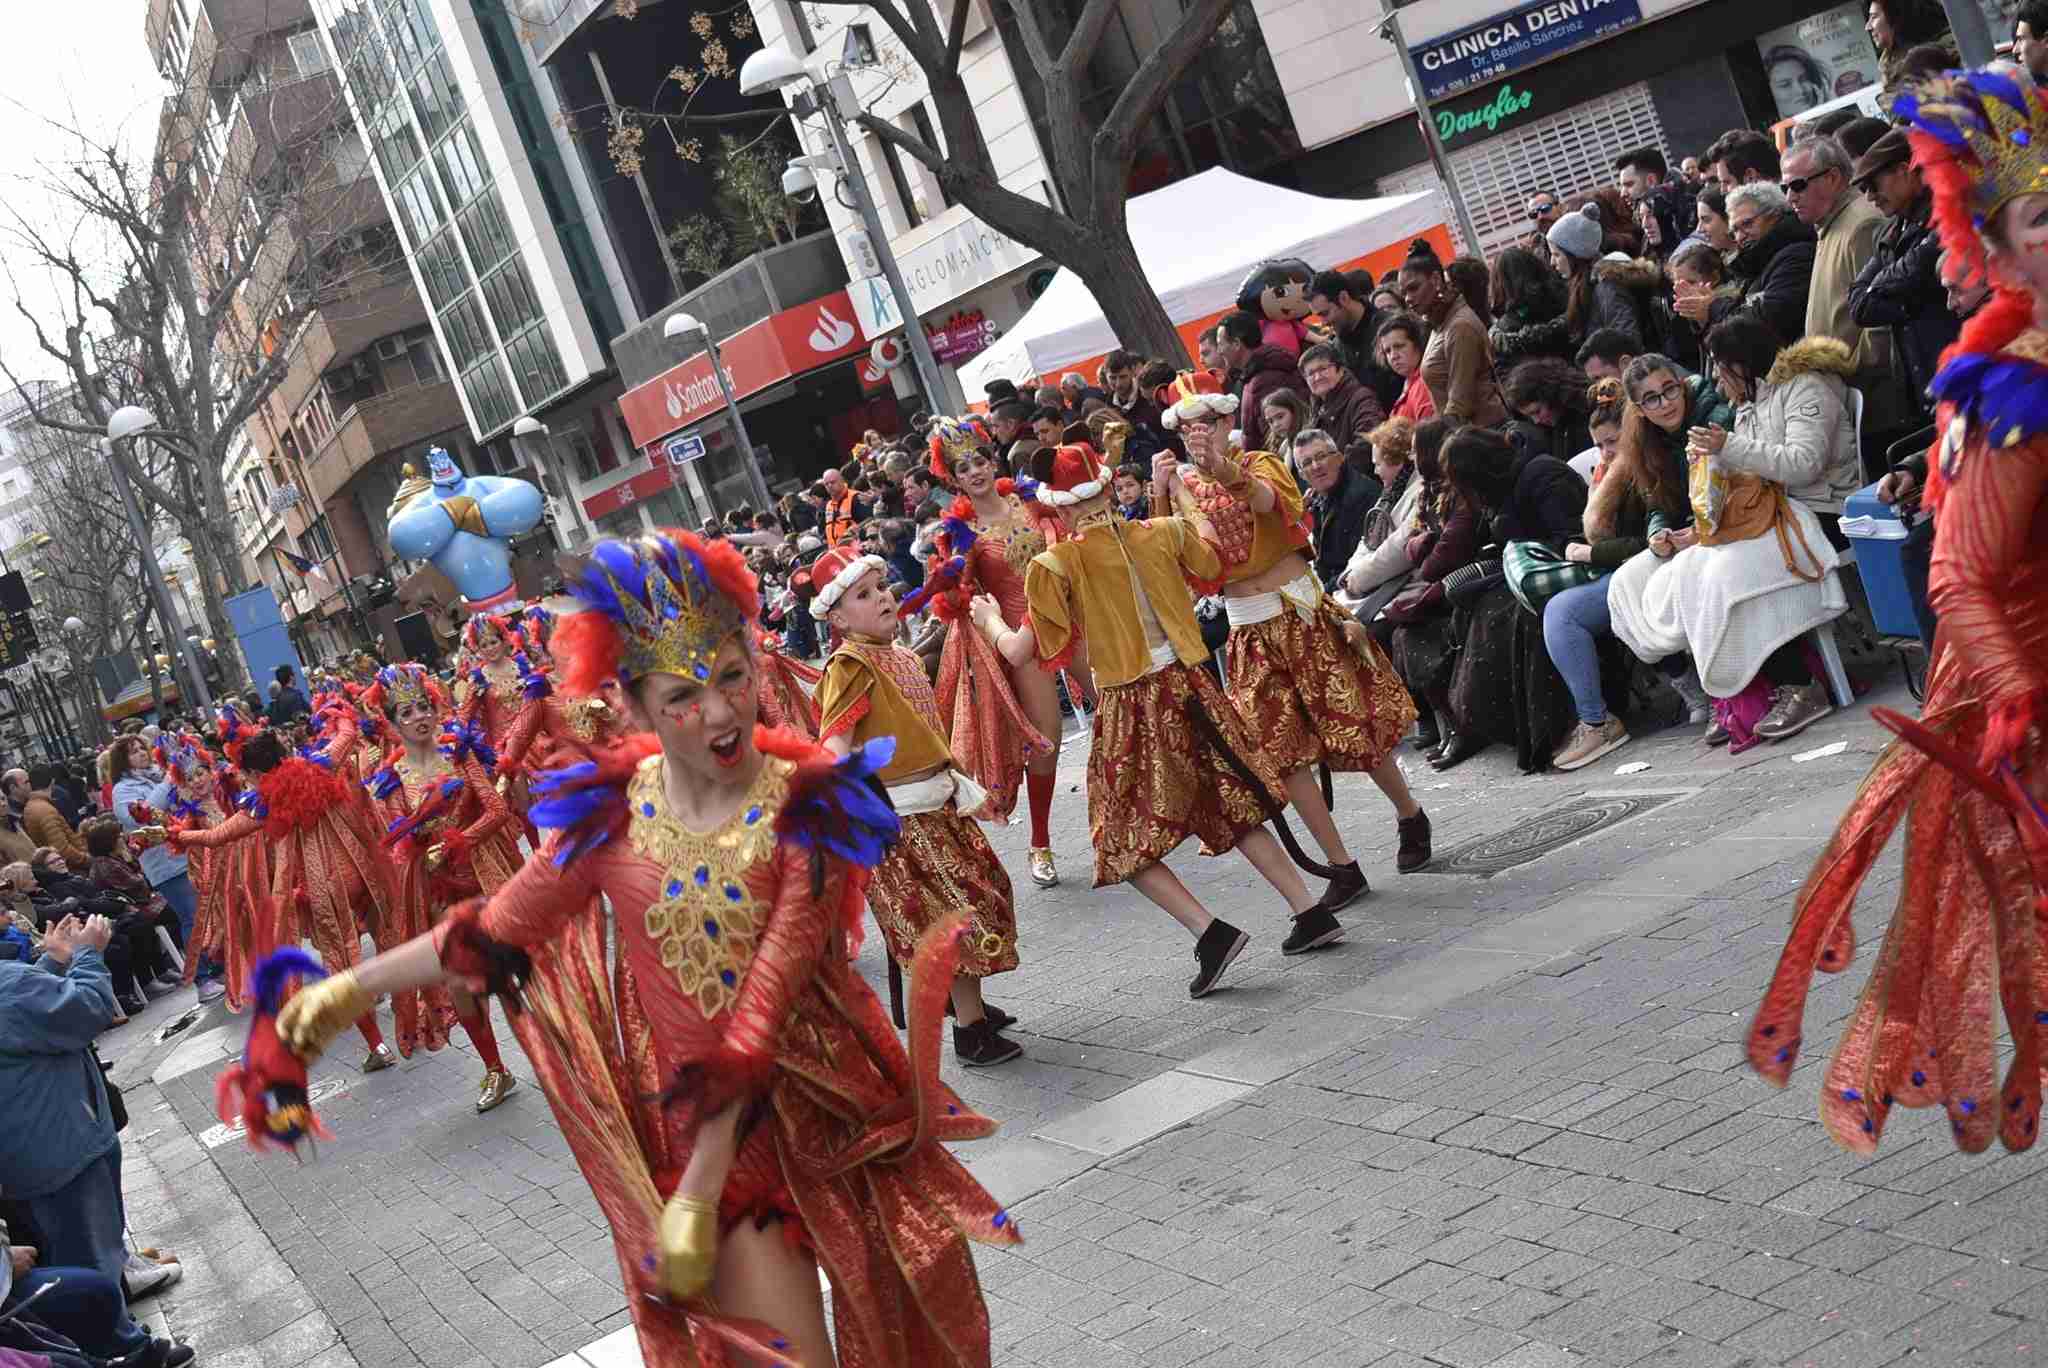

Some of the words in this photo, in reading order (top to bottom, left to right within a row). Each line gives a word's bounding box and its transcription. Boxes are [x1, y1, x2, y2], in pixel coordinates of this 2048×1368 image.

[1422, 22, 1520, 71] CLINICA
[1526, 0, 1615, 32] DENT
[1490, 40, 1531, 62] Basilio
[1436, 85, 1533, 140] Douglas
[906, 230, 1012, 297] AGLOMANCH
[676, 365, 737, 413] Santaner
